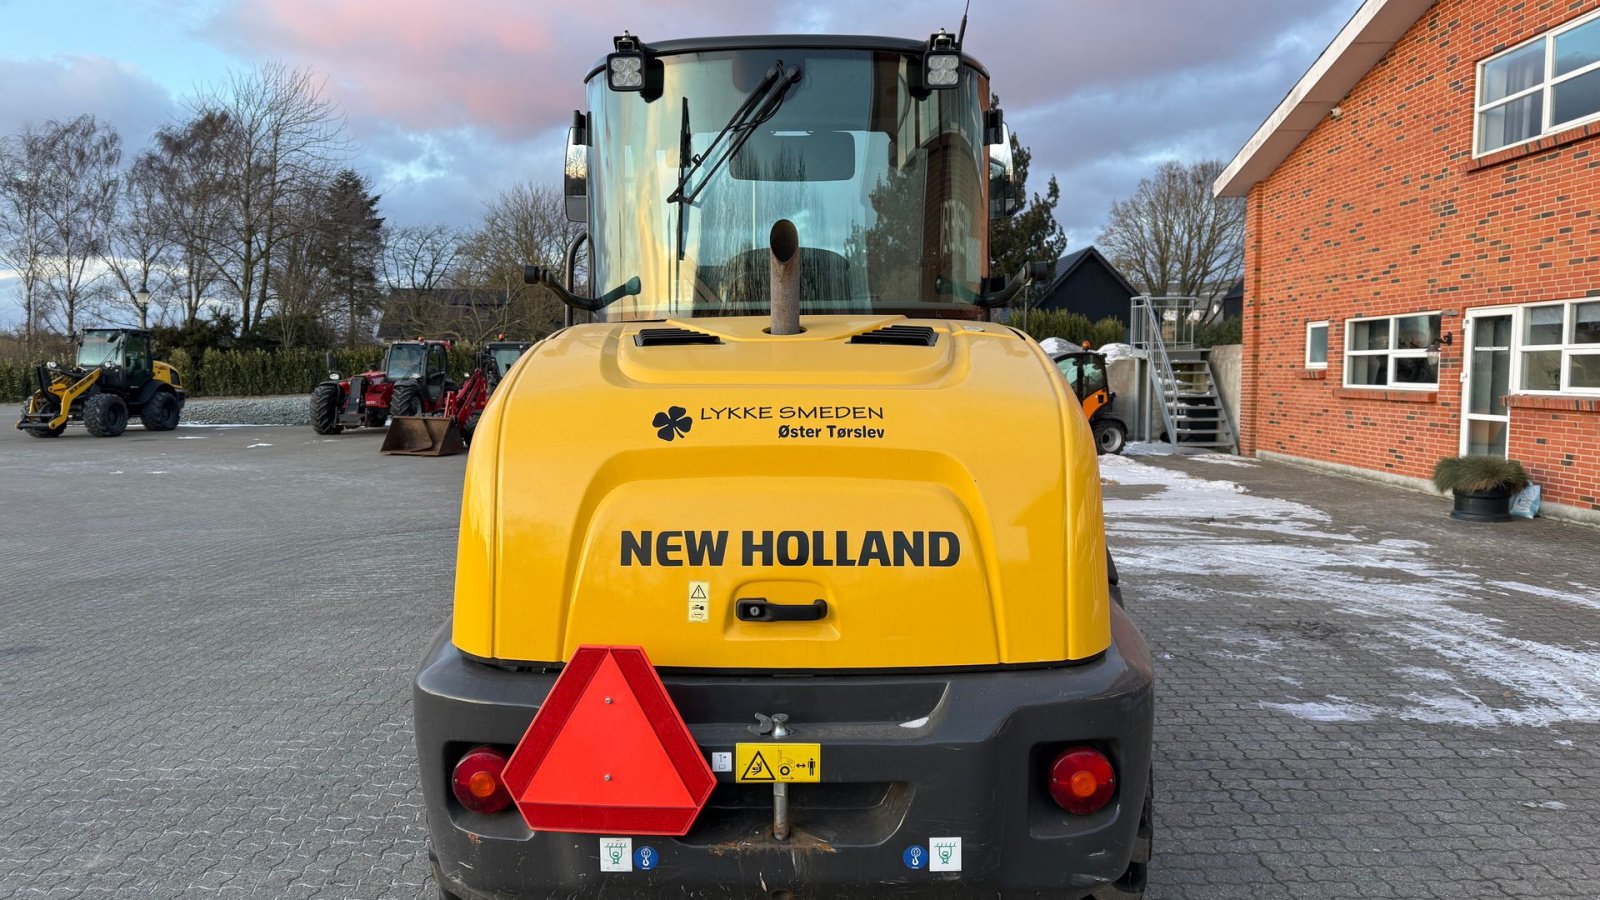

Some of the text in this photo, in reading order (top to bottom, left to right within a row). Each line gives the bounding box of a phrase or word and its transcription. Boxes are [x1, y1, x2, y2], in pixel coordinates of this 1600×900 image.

[700, 406, 884, 420] LYKKE SMEDEN
[778, 424, 884, 439] Øster Tørslev
[620, 530, 961, 567] NEW HOLLAND
